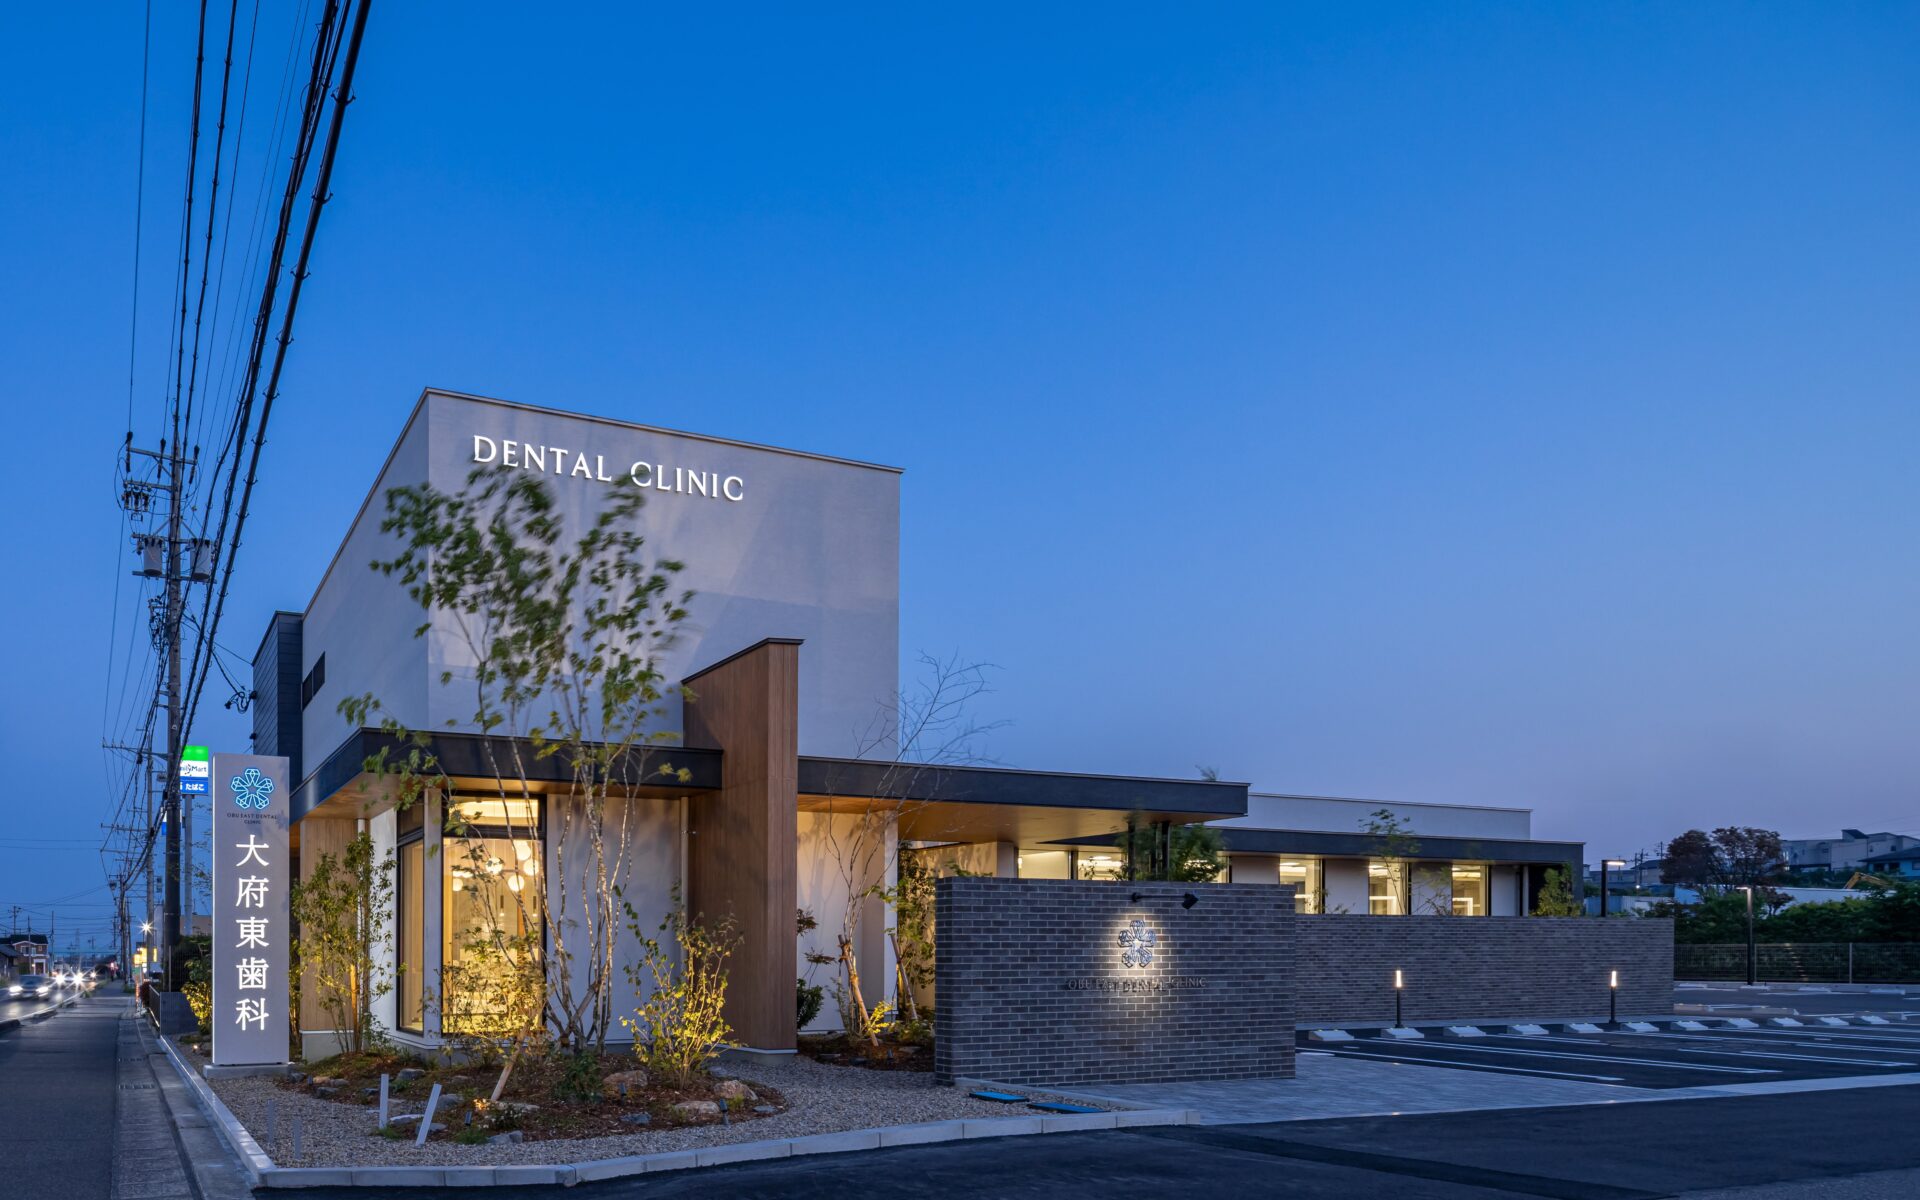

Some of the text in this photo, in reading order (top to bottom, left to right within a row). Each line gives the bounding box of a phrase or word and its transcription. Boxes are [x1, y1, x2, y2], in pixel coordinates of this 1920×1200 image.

[473, 435, 744, 501] DENTAL CLINIC
[235, 834, 270, 1031] 大府東歯科
[1068, 979, 1092, 990] OBU
[1170, 977, 1207, 988] CLINIC
